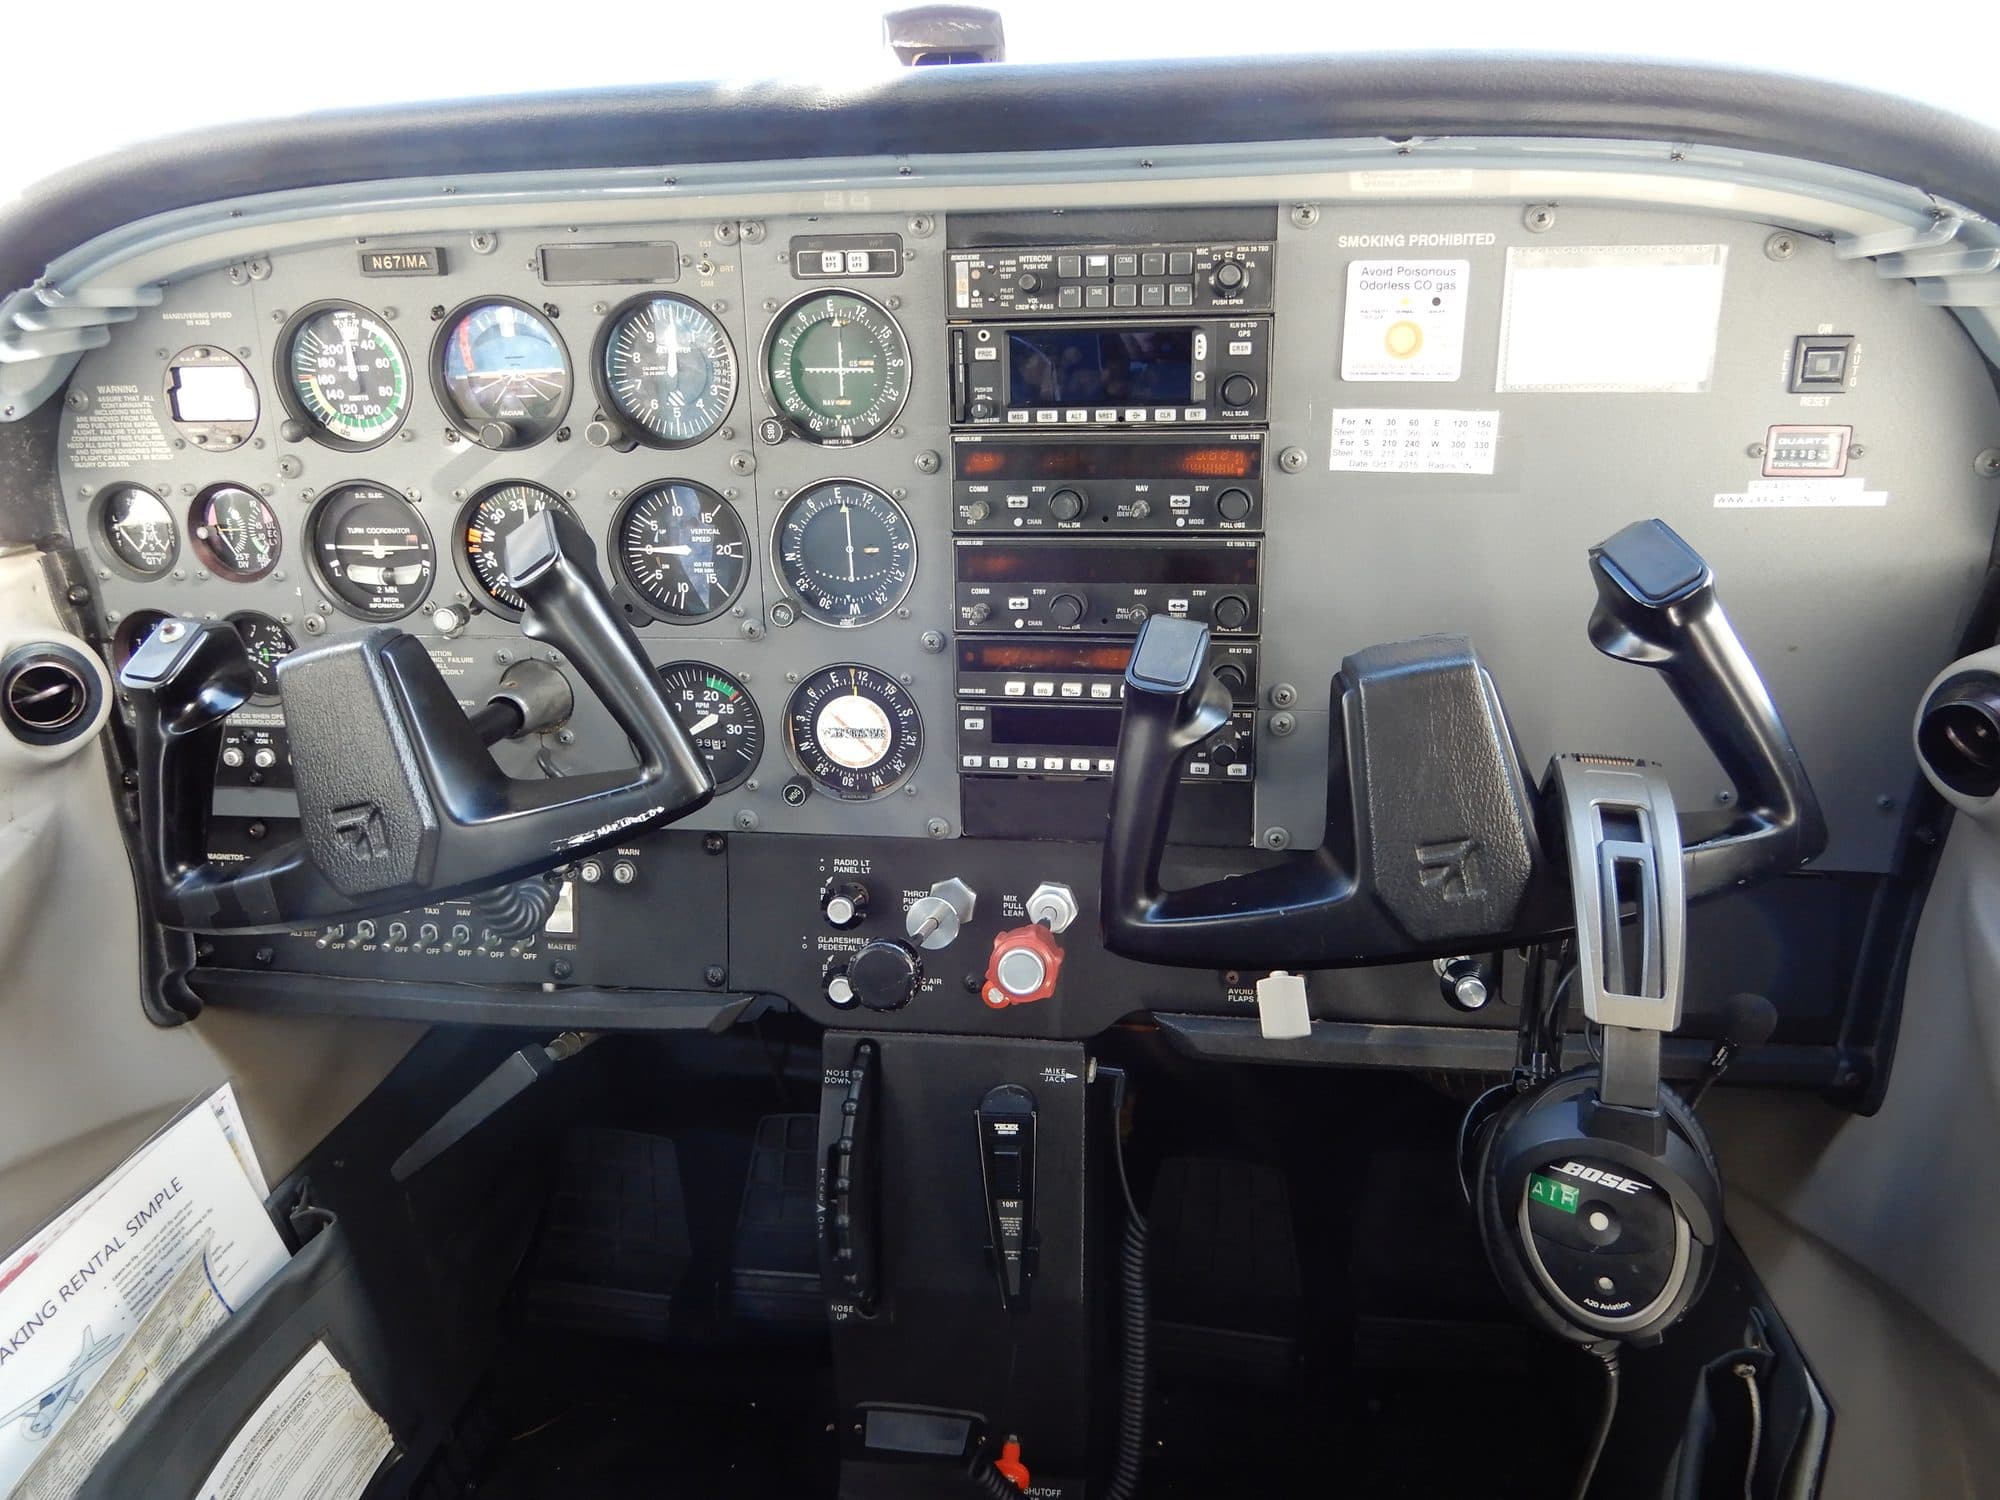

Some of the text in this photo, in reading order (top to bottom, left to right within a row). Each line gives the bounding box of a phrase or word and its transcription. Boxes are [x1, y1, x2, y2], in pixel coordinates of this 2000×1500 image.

[1338, 233, 1496, 248] SMOKING PROHIBITED
[1361, 266, 1456, 276] Avoid Poisonous
[1359, 280, 1456, 293] Odorless CO gas
[1818, 324, 1832, 334] ON
[646, 332, 654, 342] 9
[322, 344, 343, 355] 200
[361, 340, 375, 350] 40
[632, 352, 640, 363] 8
[708, 348, 715, 358] 2
[318, 357, 335, 367] 180
[376, 358, 390, 368] 60
[318, 375, 335, 385] 160
[97, 385, 138, 394] WARNING
[379, 386, 393, 396] 80
[710, 384, 718, 395] 3
[326, 390, 344, 400] 140
[651, 399, 658, 409] 6
[695, 398, 704, 408] 4
[1800, 397, 1831, 407] RESET
[340, 404, 357, 414] 120
[363, 405, 381, 415] 100
[673, 407, 681, 418] 5
[490, 508, 506, 524] 30
[672, 506, 683, 516] 10
[701, 512, 712, 523] 15
[650, 520, 658, 531] 5
[716, 545, 731, 555] 20
[334, 568, 342, 576] L
[422, 568, 430, 576] R
[655, 569, 663, 580] 5
[706, 574, 718, 584] 15
[678, 582, 689, 592] 10
[683, 690, 694, 700] 15
[703, 690, 719, 701] 20
[718, 704, 734, 714] 25
[726, 724, 742, 734] 30
[834, 859, 859, 867] RADIO
[824, 1076, 851, 1084] DOWN
[1044, 1076, 1066, 1084] JACK
[1550, 1162, 1652, 1194] BOSE
[1532, 1181, 1578, 1206] AIR
[58, 1236, 127, 1301] RENTAL
[126, 1176, 184, 1238] SIMPLE
[831, 1304, 854, 1313] NOSE
[1600, 1301, 1631, 1311] Aviation
[1023, 1488, 1062, 1497] SHUTOFF
